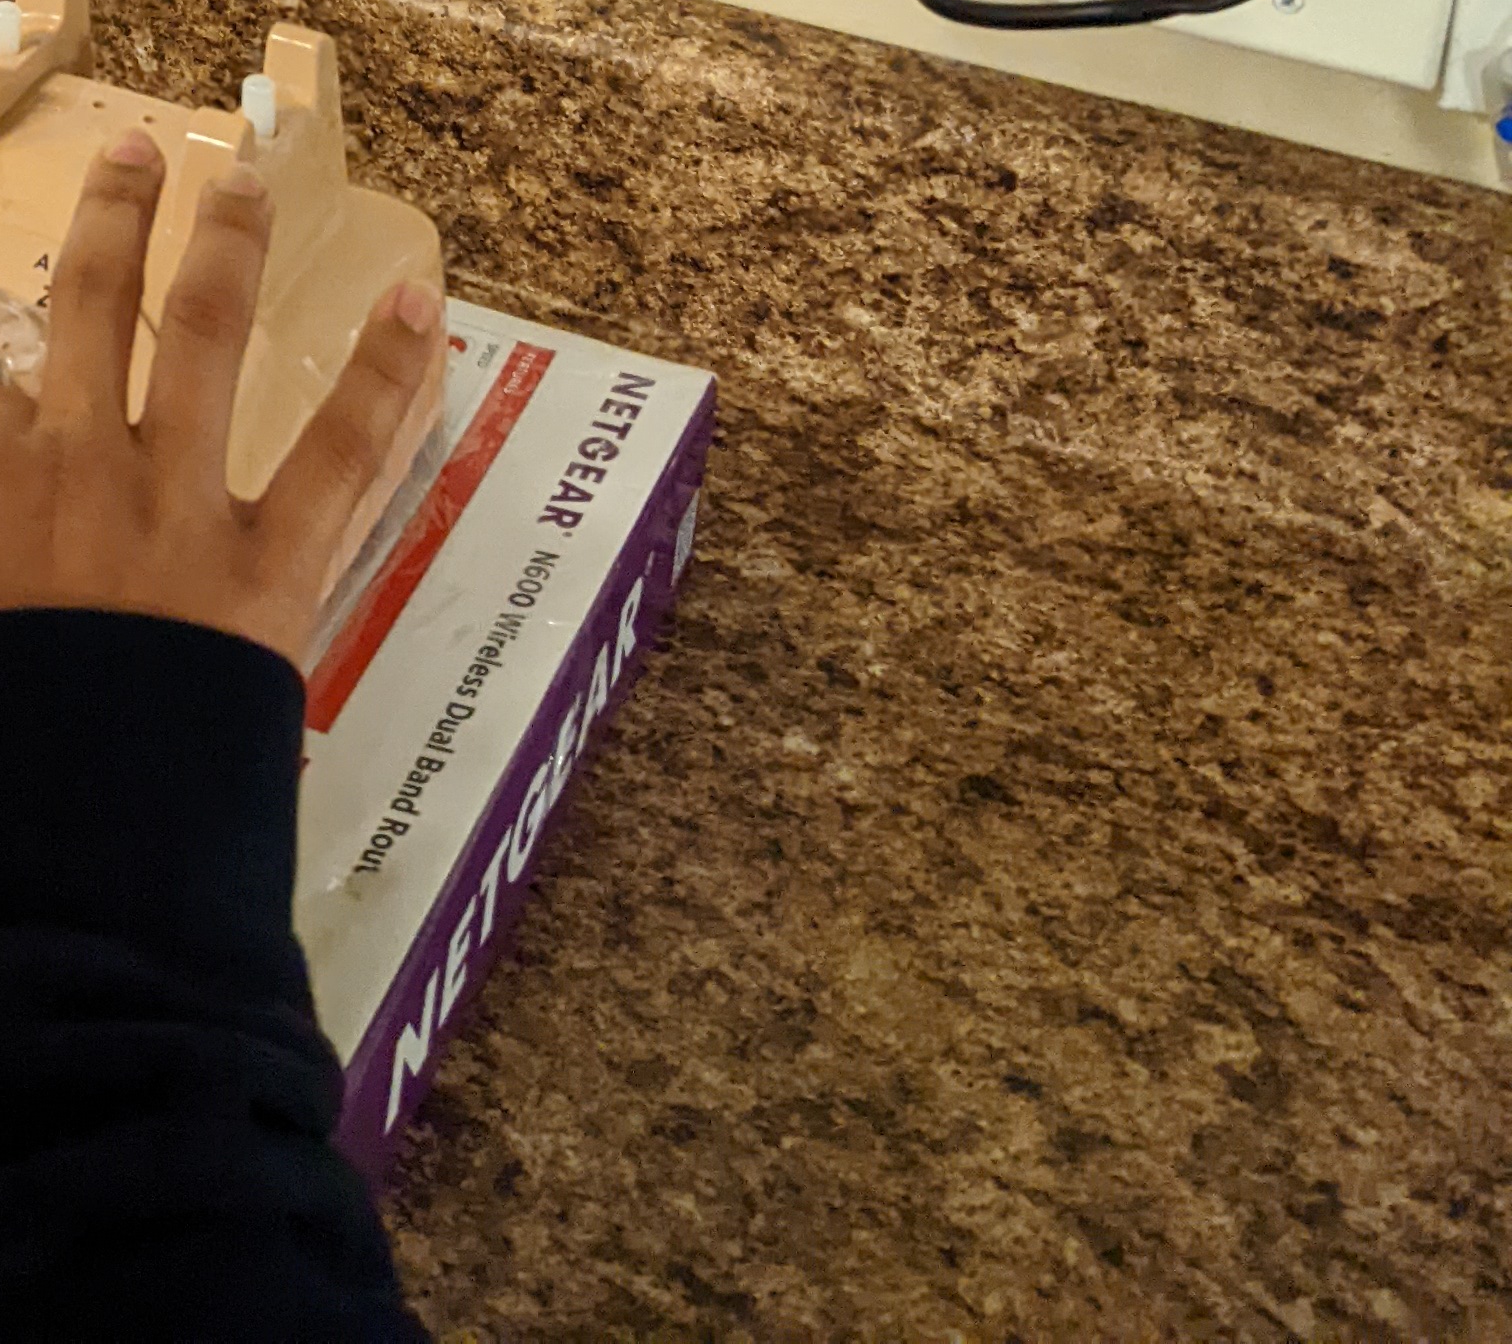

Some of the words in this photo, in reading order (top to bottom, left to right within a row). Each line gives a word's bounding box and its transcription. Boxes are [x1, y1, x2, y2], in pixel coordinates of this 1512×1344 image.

[536, 371, 657, 530] NETGEAR
[507, 549, 561, 609] N600
[455, 612, 527, 699] Wireless
[425, 701, 476, 755] Dual
[390, 756, 446, 817] Band
[385, 575, 644, 1135] NETGEAR
